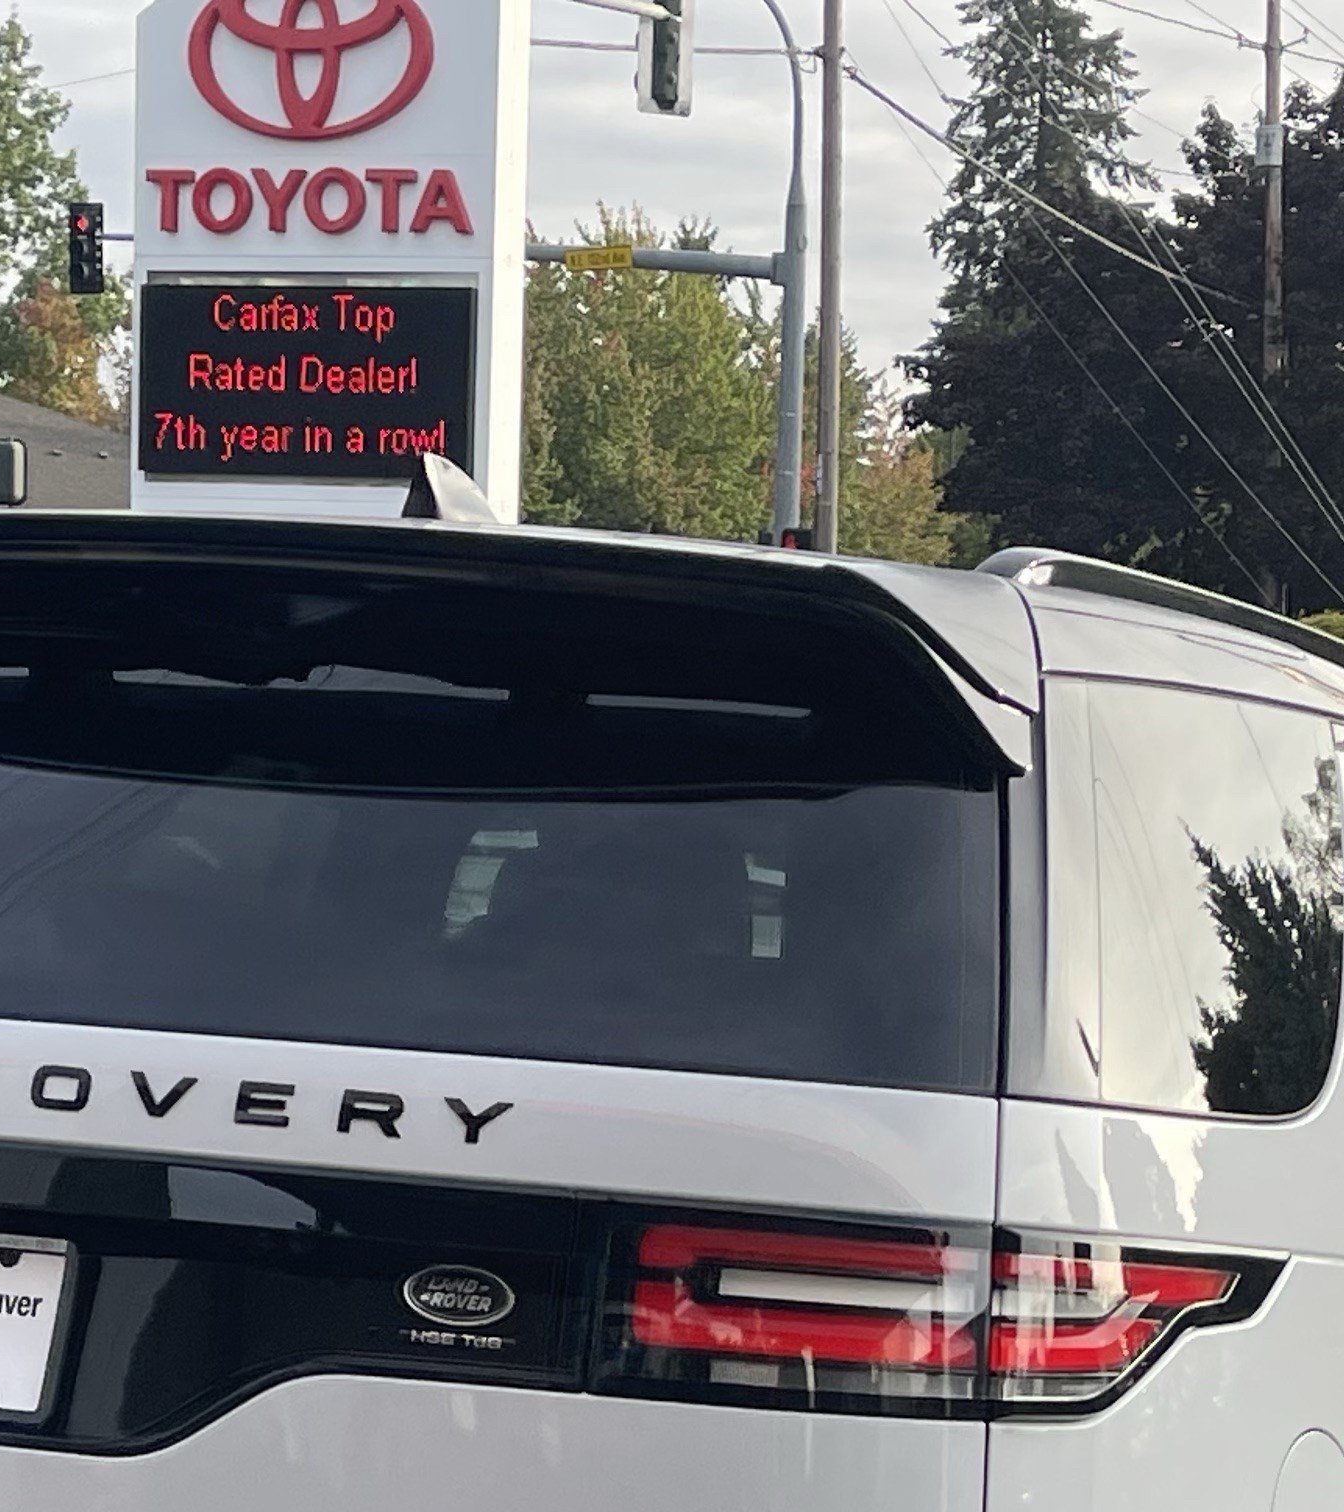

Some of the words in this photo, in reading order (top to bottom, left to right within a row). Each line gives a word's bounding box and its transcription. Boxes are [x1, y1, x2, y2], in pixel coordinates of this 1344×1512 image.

[145, 166, 475, 236] TOYOTA
[212, 293, 321, 332] Carfax
[331, 293, 396, 344] Top
[187, 353, 287, 393] Rated
[298, 354, 419, 395] Dealer!
[154, 412, 208, 452] 7th
[219, 422, 295, 463] year
[304, 417, 334, 454] in
[345, 426, 365, 455] a
[378, 419, 446, 457] row!
[427, 1278, 480, 1293] LAND
[429, 1291, 493, 1313] ROVER
